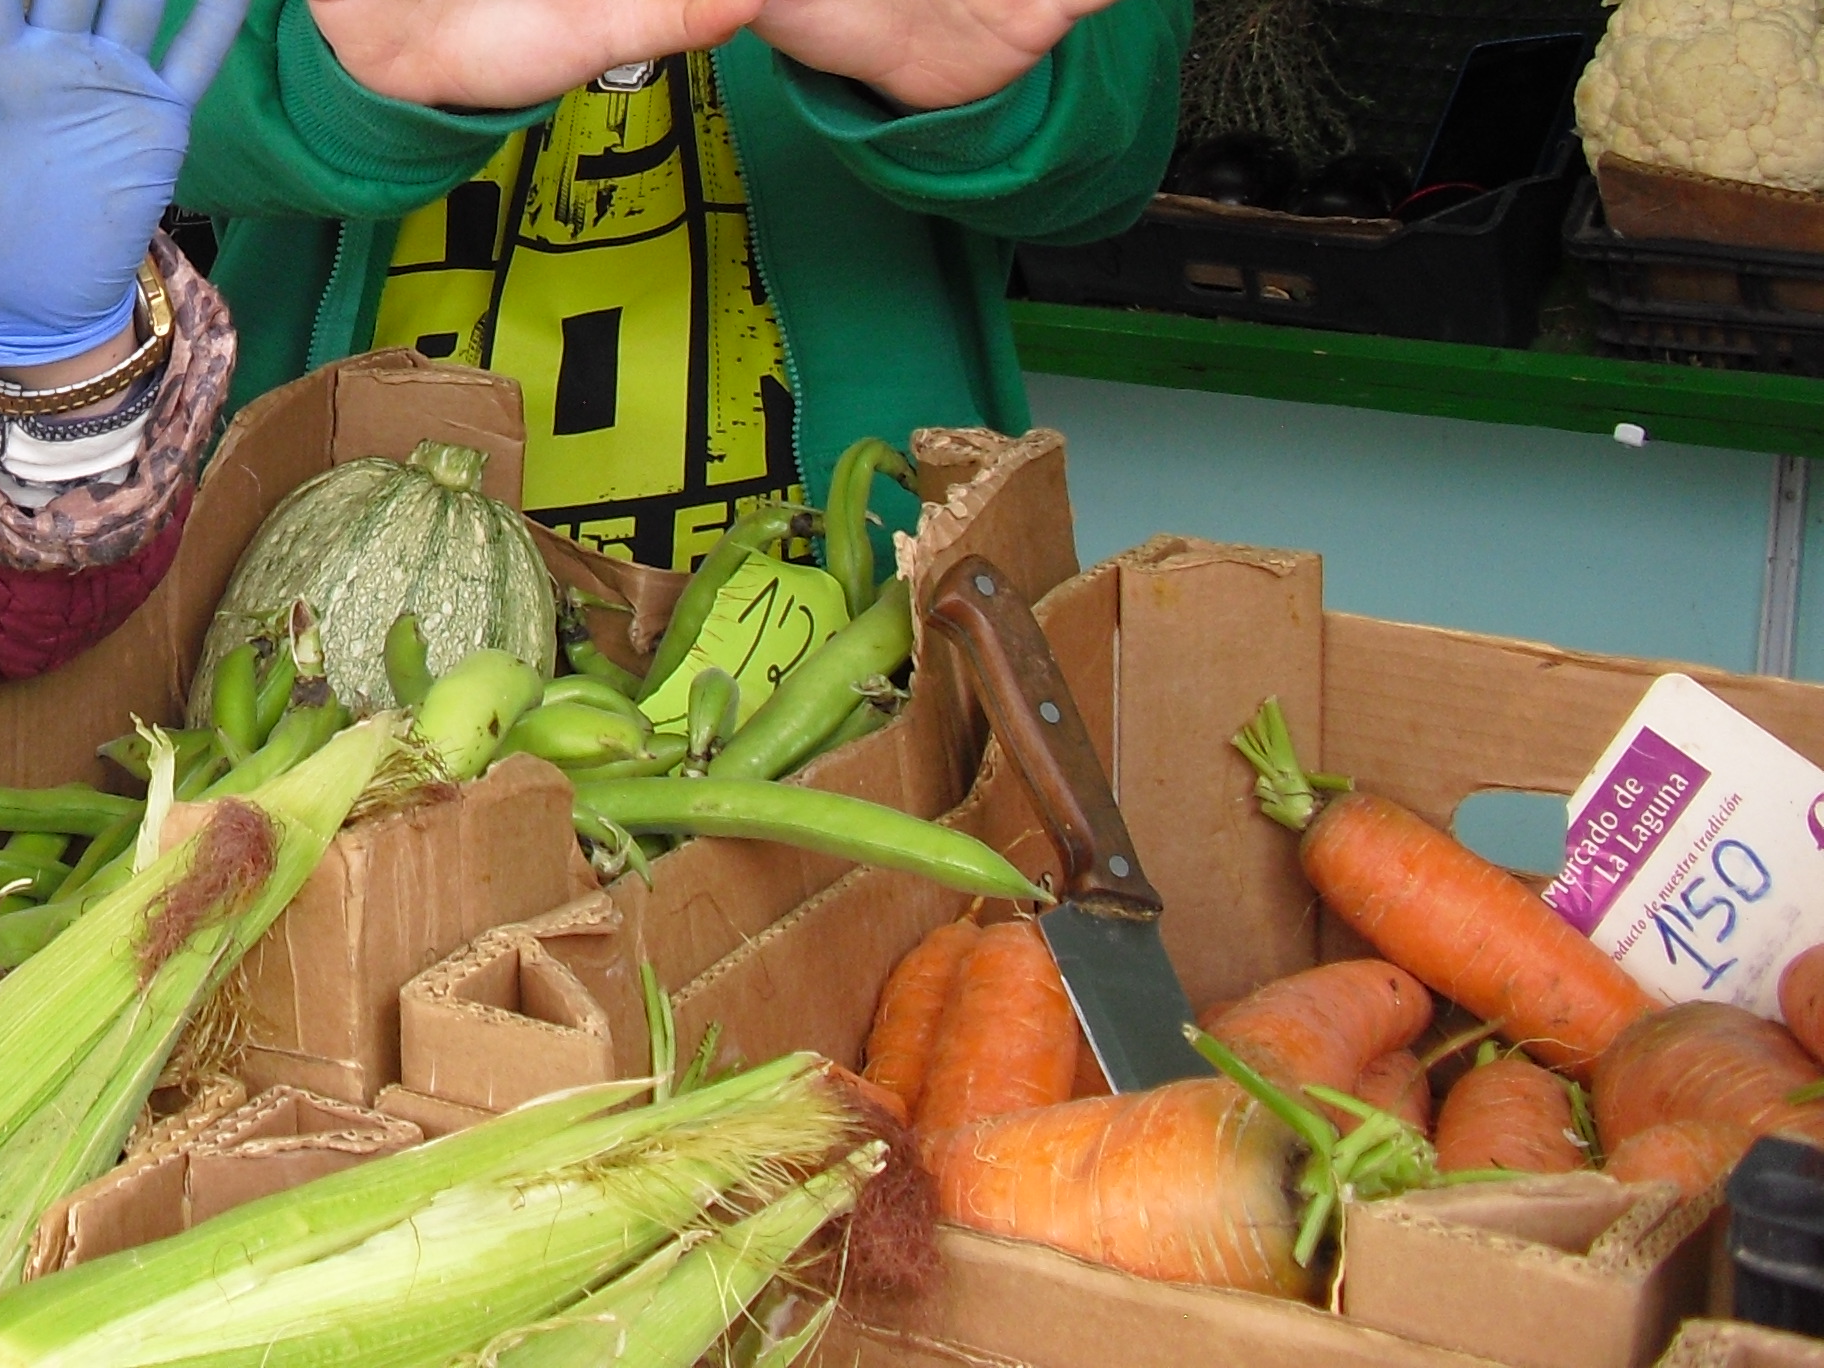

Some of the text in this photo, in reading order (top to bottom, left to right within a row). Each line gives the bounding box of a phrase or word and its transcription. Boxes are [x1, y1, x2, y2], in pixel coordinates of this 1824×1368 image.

[1540, 777, 1644, 909] Mercado de
[1594, 773, 1689, 884] La Laguna
[1611, 792, 1743, 962] oducto de nuestra tradición
